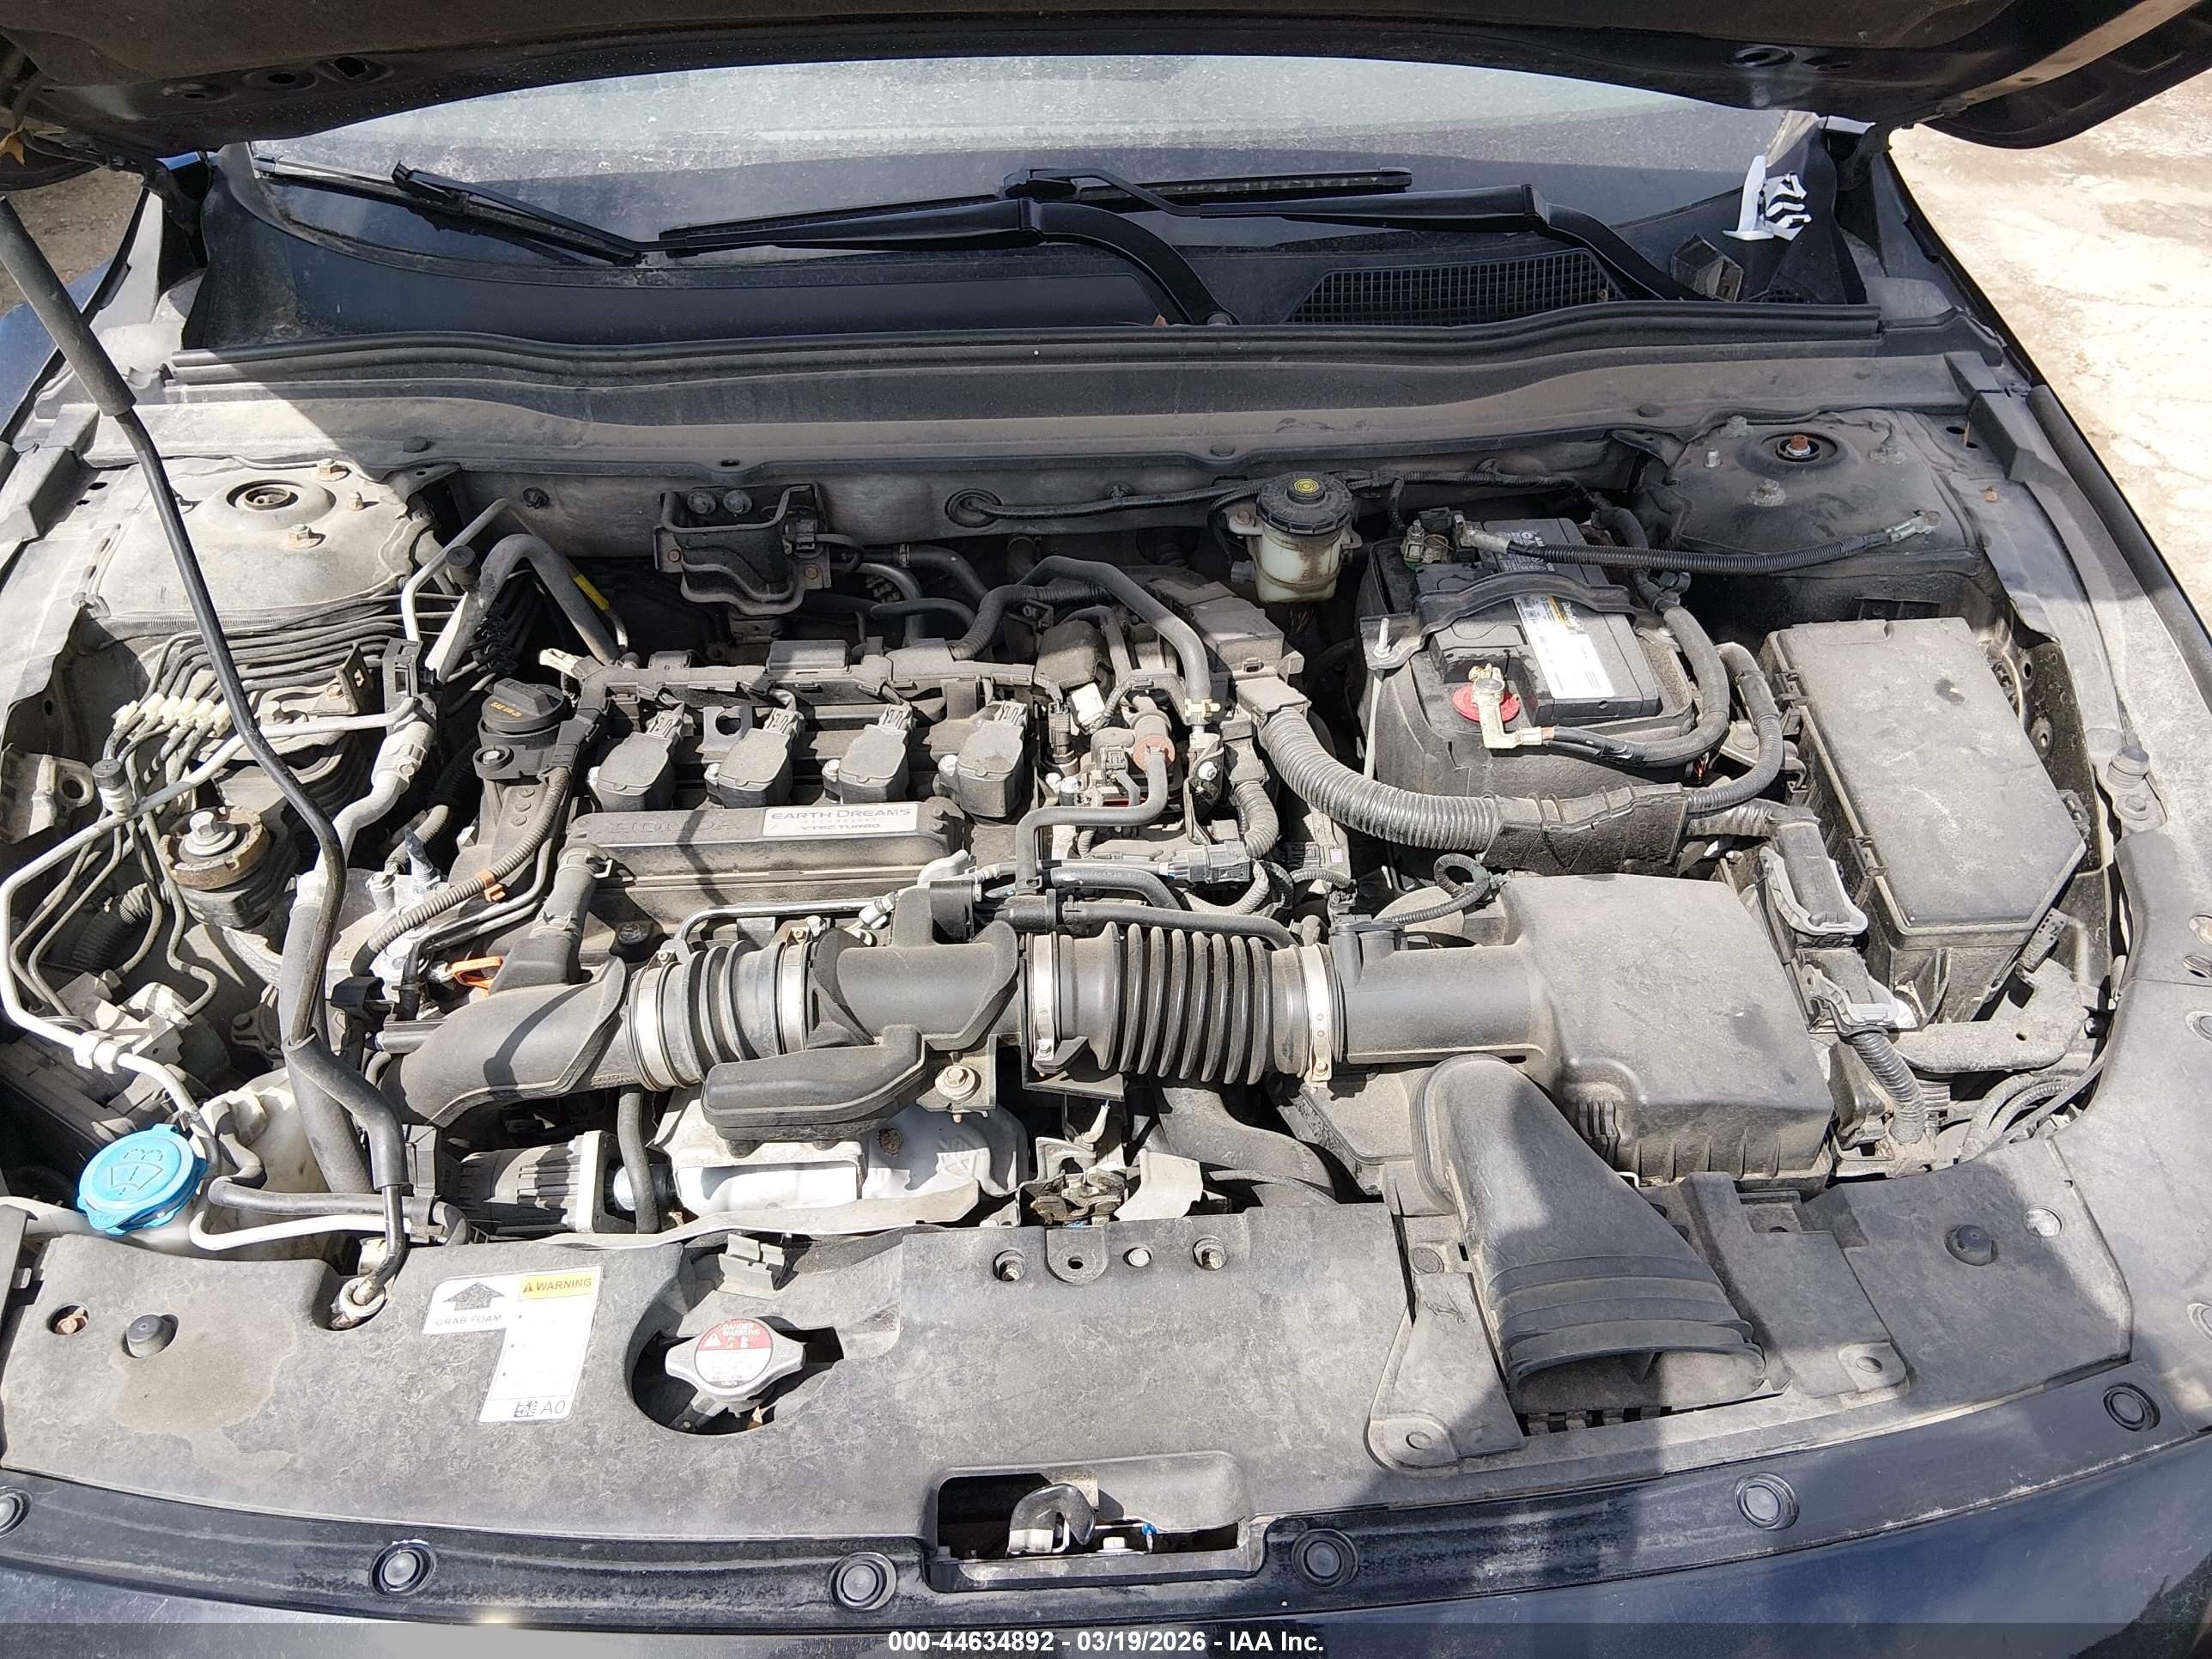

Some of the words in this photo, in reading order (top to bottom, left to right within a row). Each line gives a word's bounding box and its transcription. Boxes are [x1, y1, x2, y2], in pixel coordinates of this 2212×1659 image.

[771, 811, 832, 820] EARTH
[836, 808, 912, 817] DREAMS
[536, 1278, 592, 1291] WARNING
[540, 1400, 566, 1415] A0
